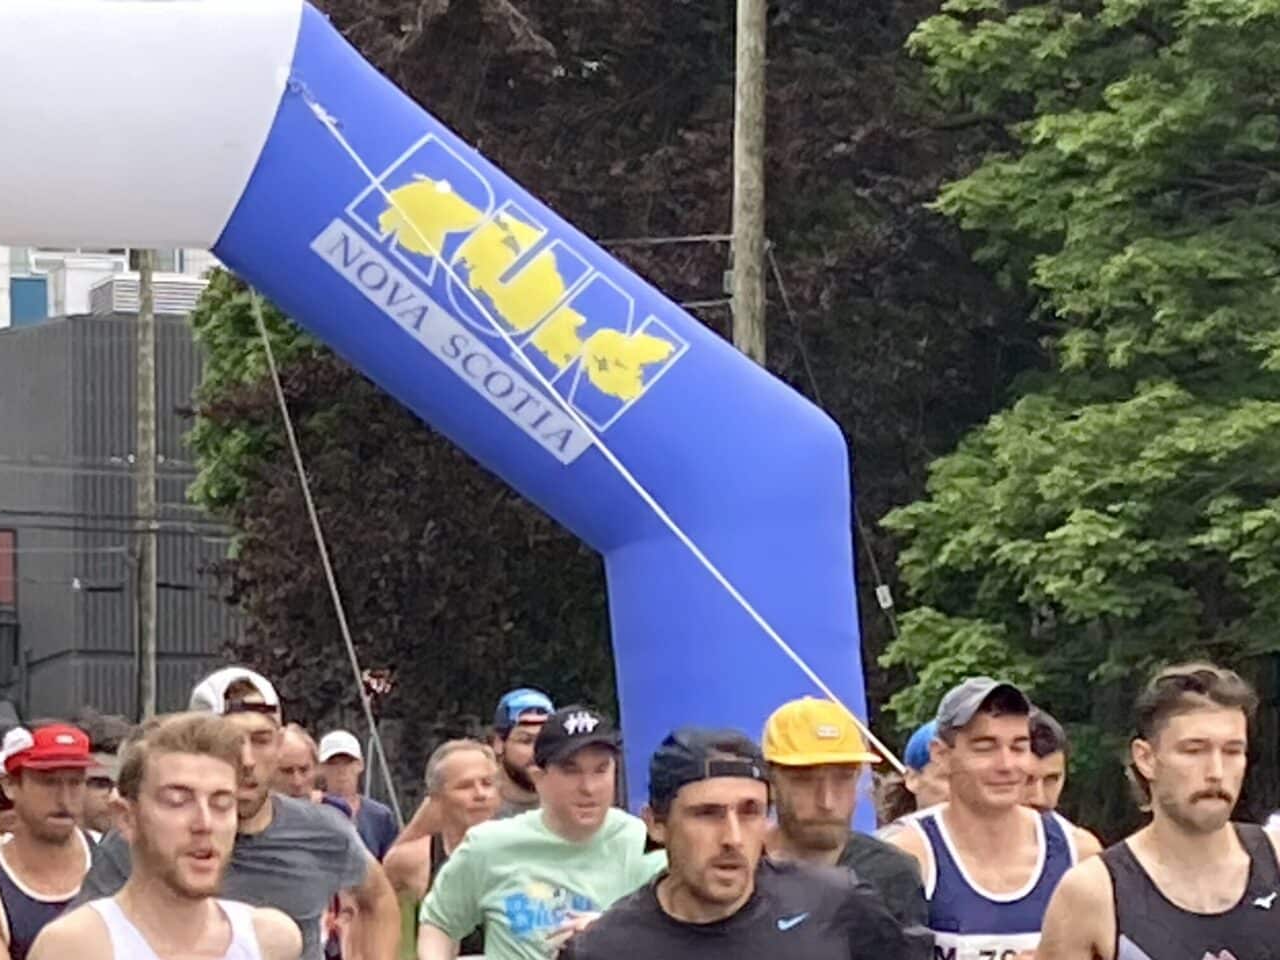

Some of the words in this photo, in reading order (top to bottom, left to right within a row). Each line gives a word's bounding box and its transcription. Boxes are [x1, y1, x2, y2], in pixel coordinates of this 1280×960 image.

[329, 234, 433, 331] NOVA
[441, 334, 576, 453] SCOTIA
[344, 133, 691, 432] RUN
